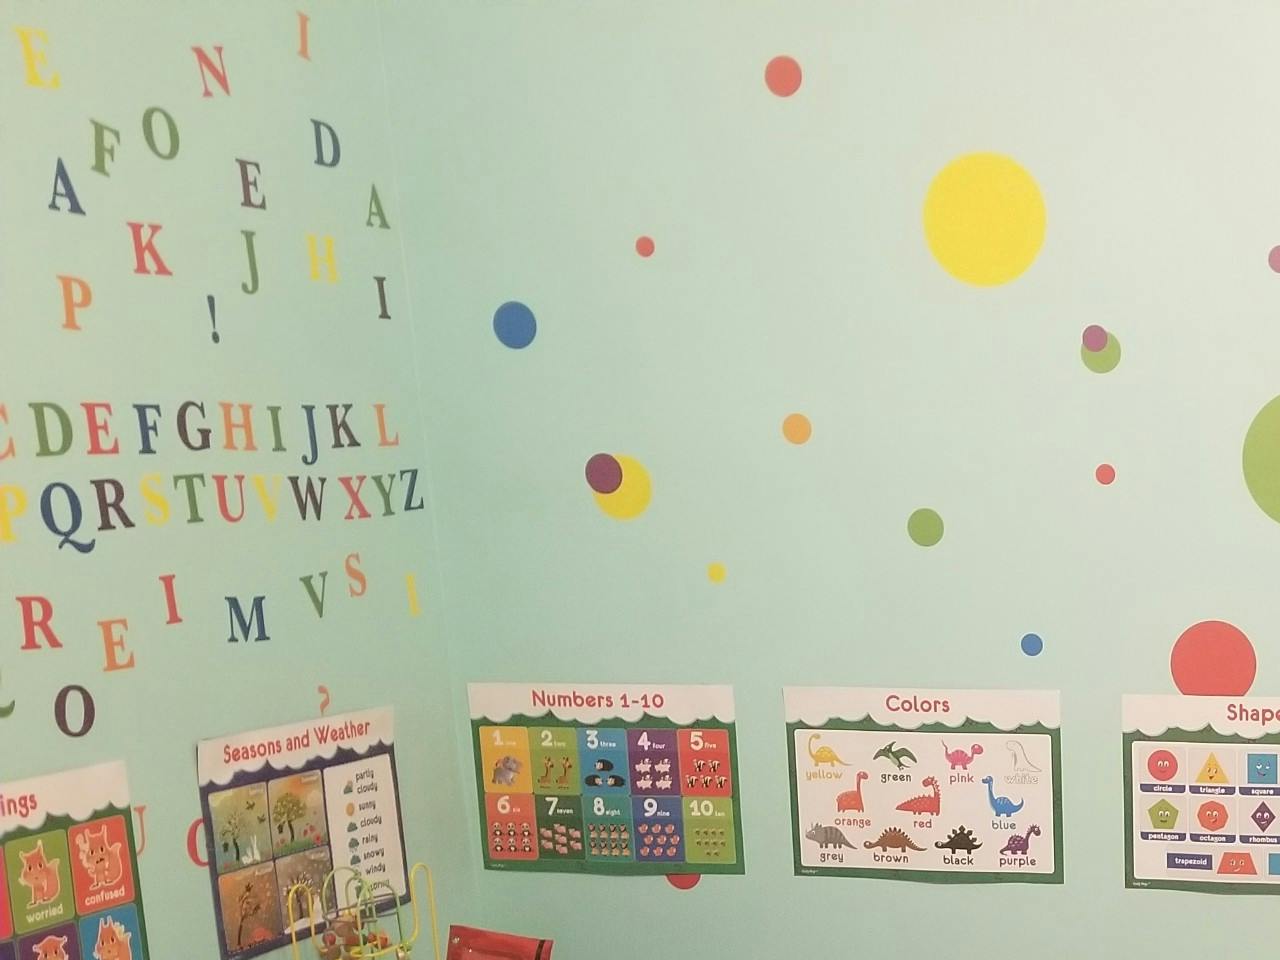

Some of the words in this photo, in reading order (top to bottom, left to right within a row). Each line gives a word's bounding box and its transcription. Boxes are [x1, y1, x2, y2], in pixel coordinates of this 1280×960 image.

[298, 12, 310, 60] I
[15, 27, 61, 89] E
[192, 46, 230, 97] N
[142, 107, 179, 160] O
[90, 120, 120, 177] F
[311, 119, 340, 168] D
[49, 158, 86, 215] A
[236, 159, 266, 210] E
[366, 184, 390, 229] A
[127, 222, 172, 276] K
[241, 230, 258, 294] J
[307, 235, 339, 283] H
[58, 276, 92, 330] P
[374, 277, 391, 319] I
[345, 553, 366, 597] S
[159, 574, 182, 624] I
[299, 571, 328, 618] V
[405, 573, 421, 617] I
[16, 596, 63, 650] R
[225, 596, 270, 642] M
[97, 619, 135, 672] E
[532, 690, 613, 707] Numbers
[620, 694, 663, 708] 1-10
[886, 695, 949, 712] Colors
[55, 685, 95, 737] O
[223, 733, 282, 763] Seasons
[286, 729, 310, 752] and
[314, 721, 371, 745] Weather
[492, 730, 503, 746] 1
[541, 730, 552, 746] 2
[586, 730, 598, 749] 3
[638, 732, 651, 750] 4
[690, 732, 704, 750] 5
[806, 771, 843, 780] yellow
[881, 774, 911, 783] green
[950, 773, 974, 784] pink
[357, 782, 378, 794] cloudy
[497, 796, 510, 814] 6
[545, 797, 558, 816] 7
[594, 797, 604, 815] 8
[644, 798, 657, 817] 9
[689, 800, 714, 816] 10
[360, 815, 382, 828] cloudy
[834, 817, 871, 828] orange
[914, 819, 932, 828] red
[992, 820, 1016, 829] blue
[820, 853, 843, 862] grey
[874, 853, 908, 862] brown
[944, 855, 973, 865] black
[1000, 856, 1036, 867] purple
